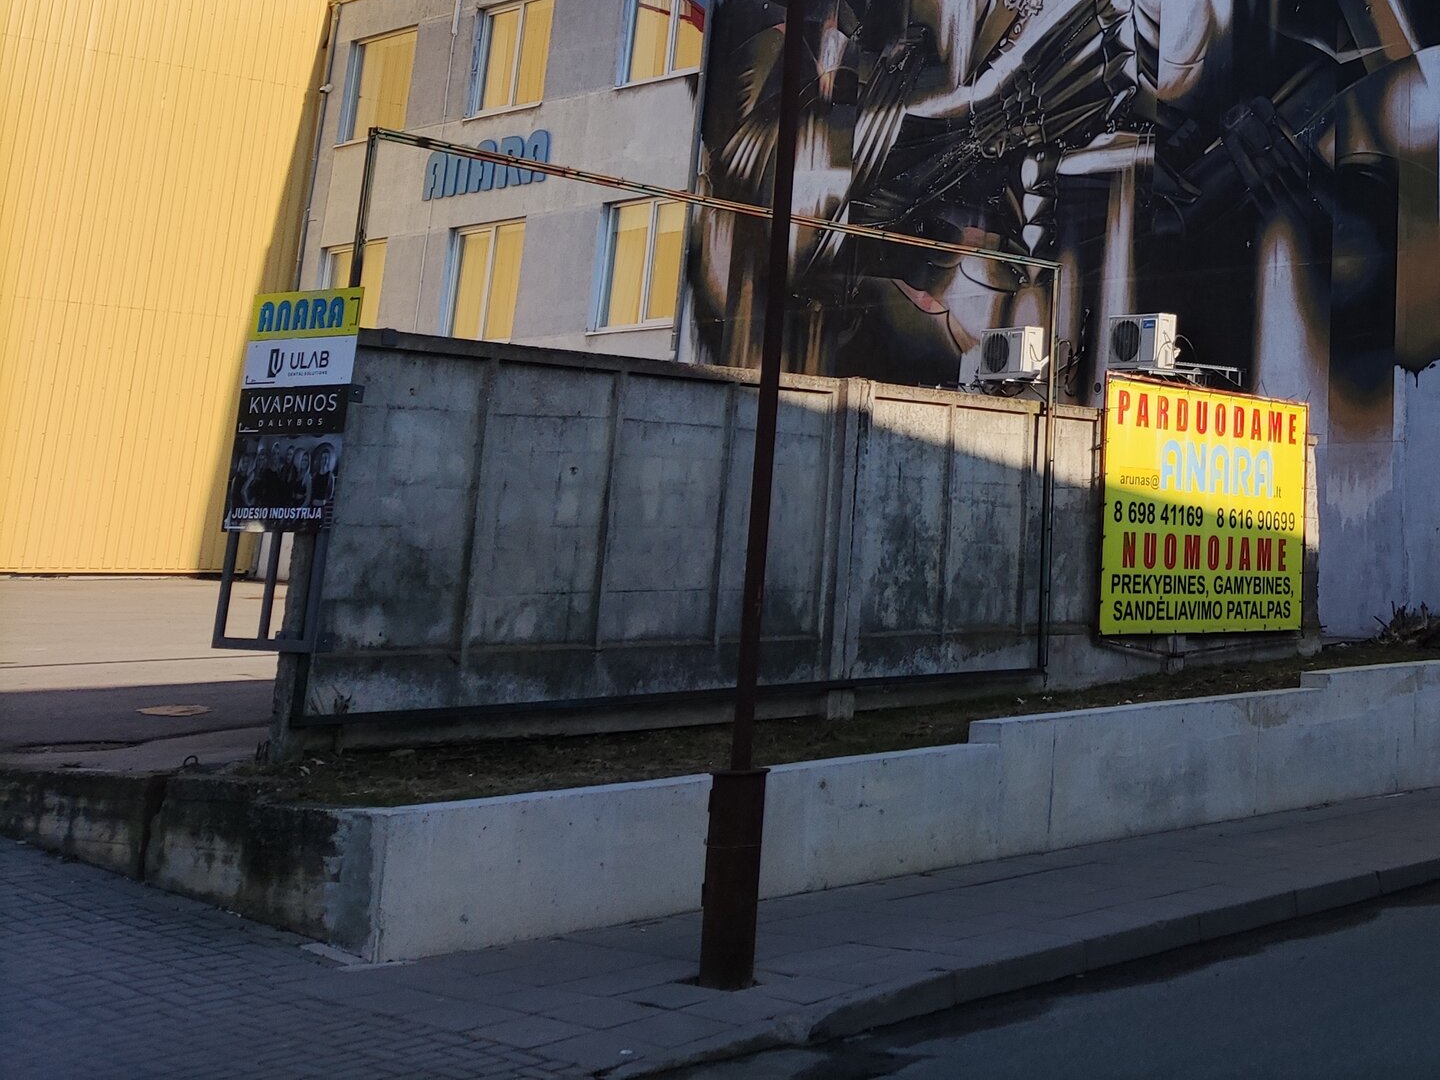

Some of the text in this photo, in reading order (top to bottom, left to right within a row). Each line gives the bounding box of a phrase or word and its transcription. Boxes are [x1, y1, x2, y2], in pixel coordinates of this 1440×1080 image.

[422, 129, 549, 201] ANARA
[257, 296, 344, 332] ANARA
[290, 351, 329, 370] ULAB
[249, 394, 338, 414] KVAPNIOS
[258, 418, 324, 427] DALYBOS
[1118, 390, 1297, 445] PARDUODAME
[232, 507, 322, 519] JUDESIO INDUSTRIJA
[1113, 500, 1296, 531] 8 698 41169 8 616 90699
[1122, 532, 1287, 572] NUOMOJAME
[1111, 574, 1295, 598] PREKYBINES, GAMYBINES,
[1113, 596, 1291, 621] SANDĖLIAVIMO PATALPAS
